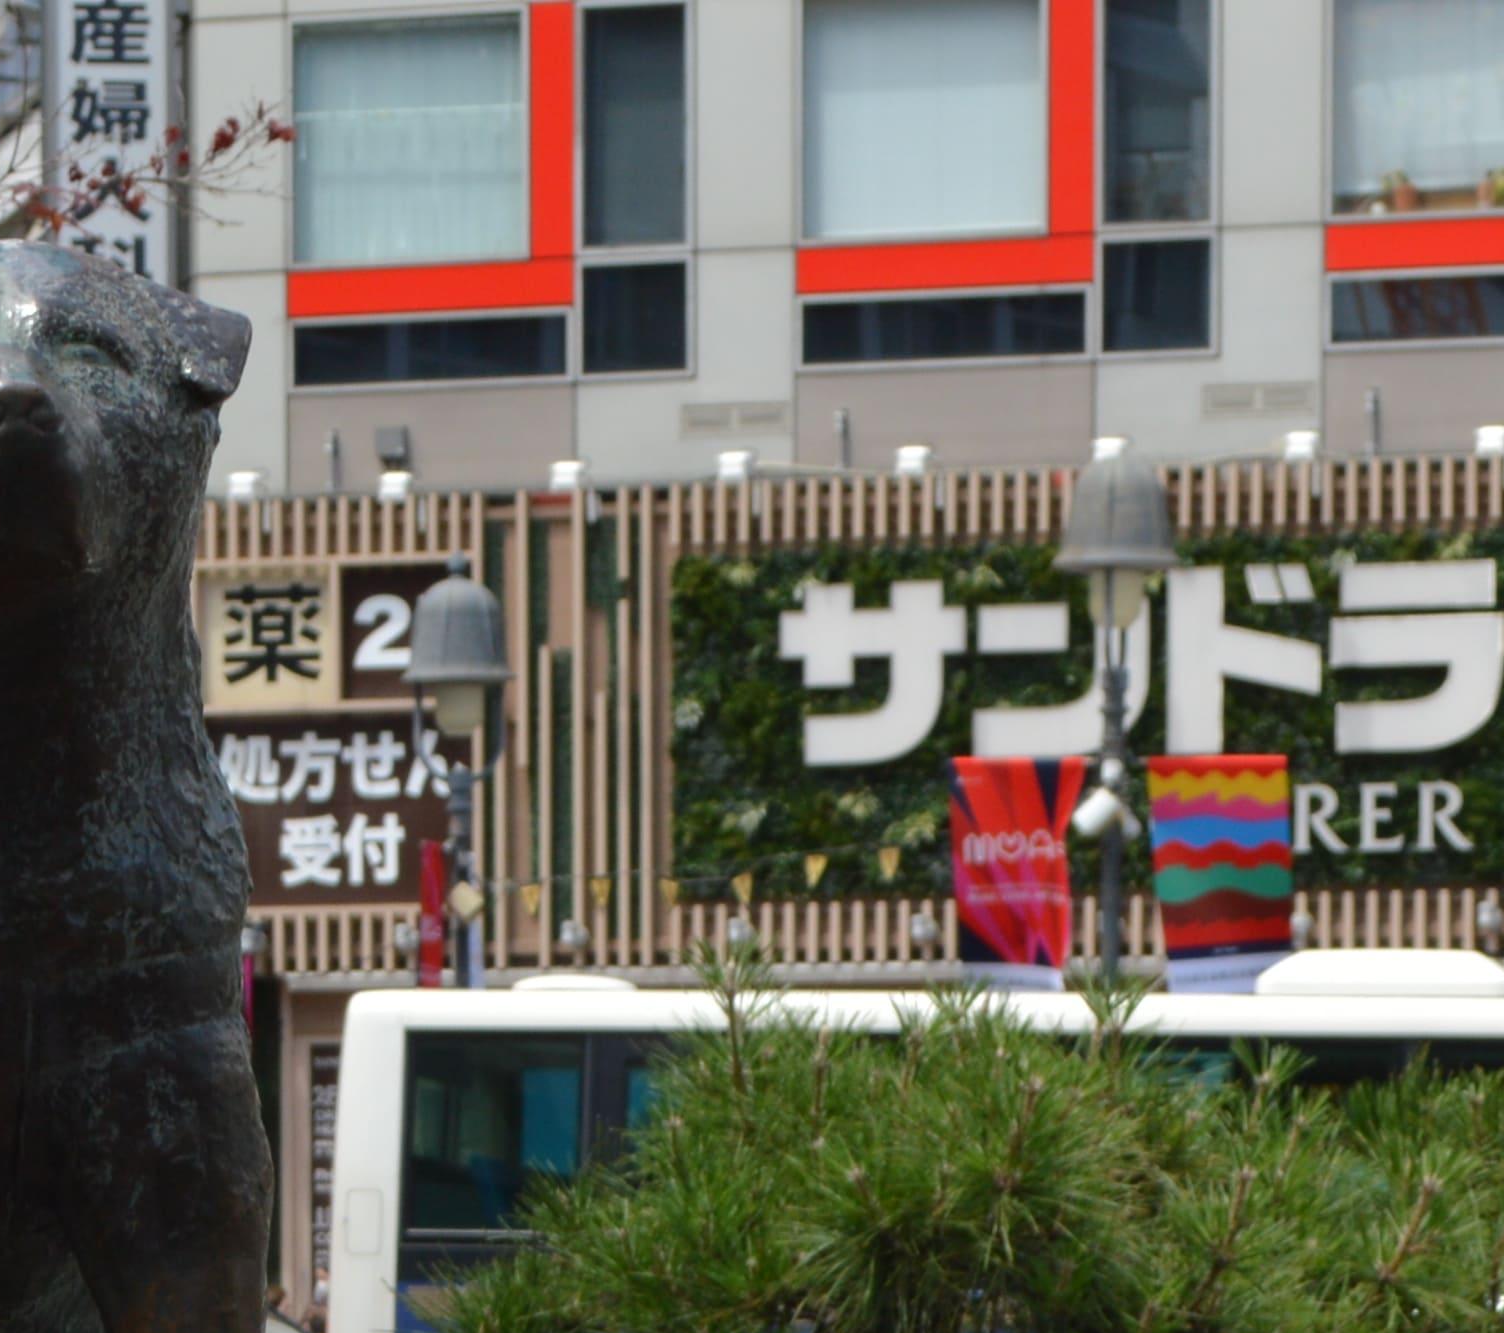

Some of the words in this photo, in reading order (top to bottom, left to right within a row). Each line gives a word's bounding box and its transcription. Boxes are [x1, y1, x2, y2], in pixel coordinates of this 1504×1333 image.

[223, 582, 322, 684] 薬
[219, 731, 451, 803] 処方せん
[278, 813, 406, 887] 受付
